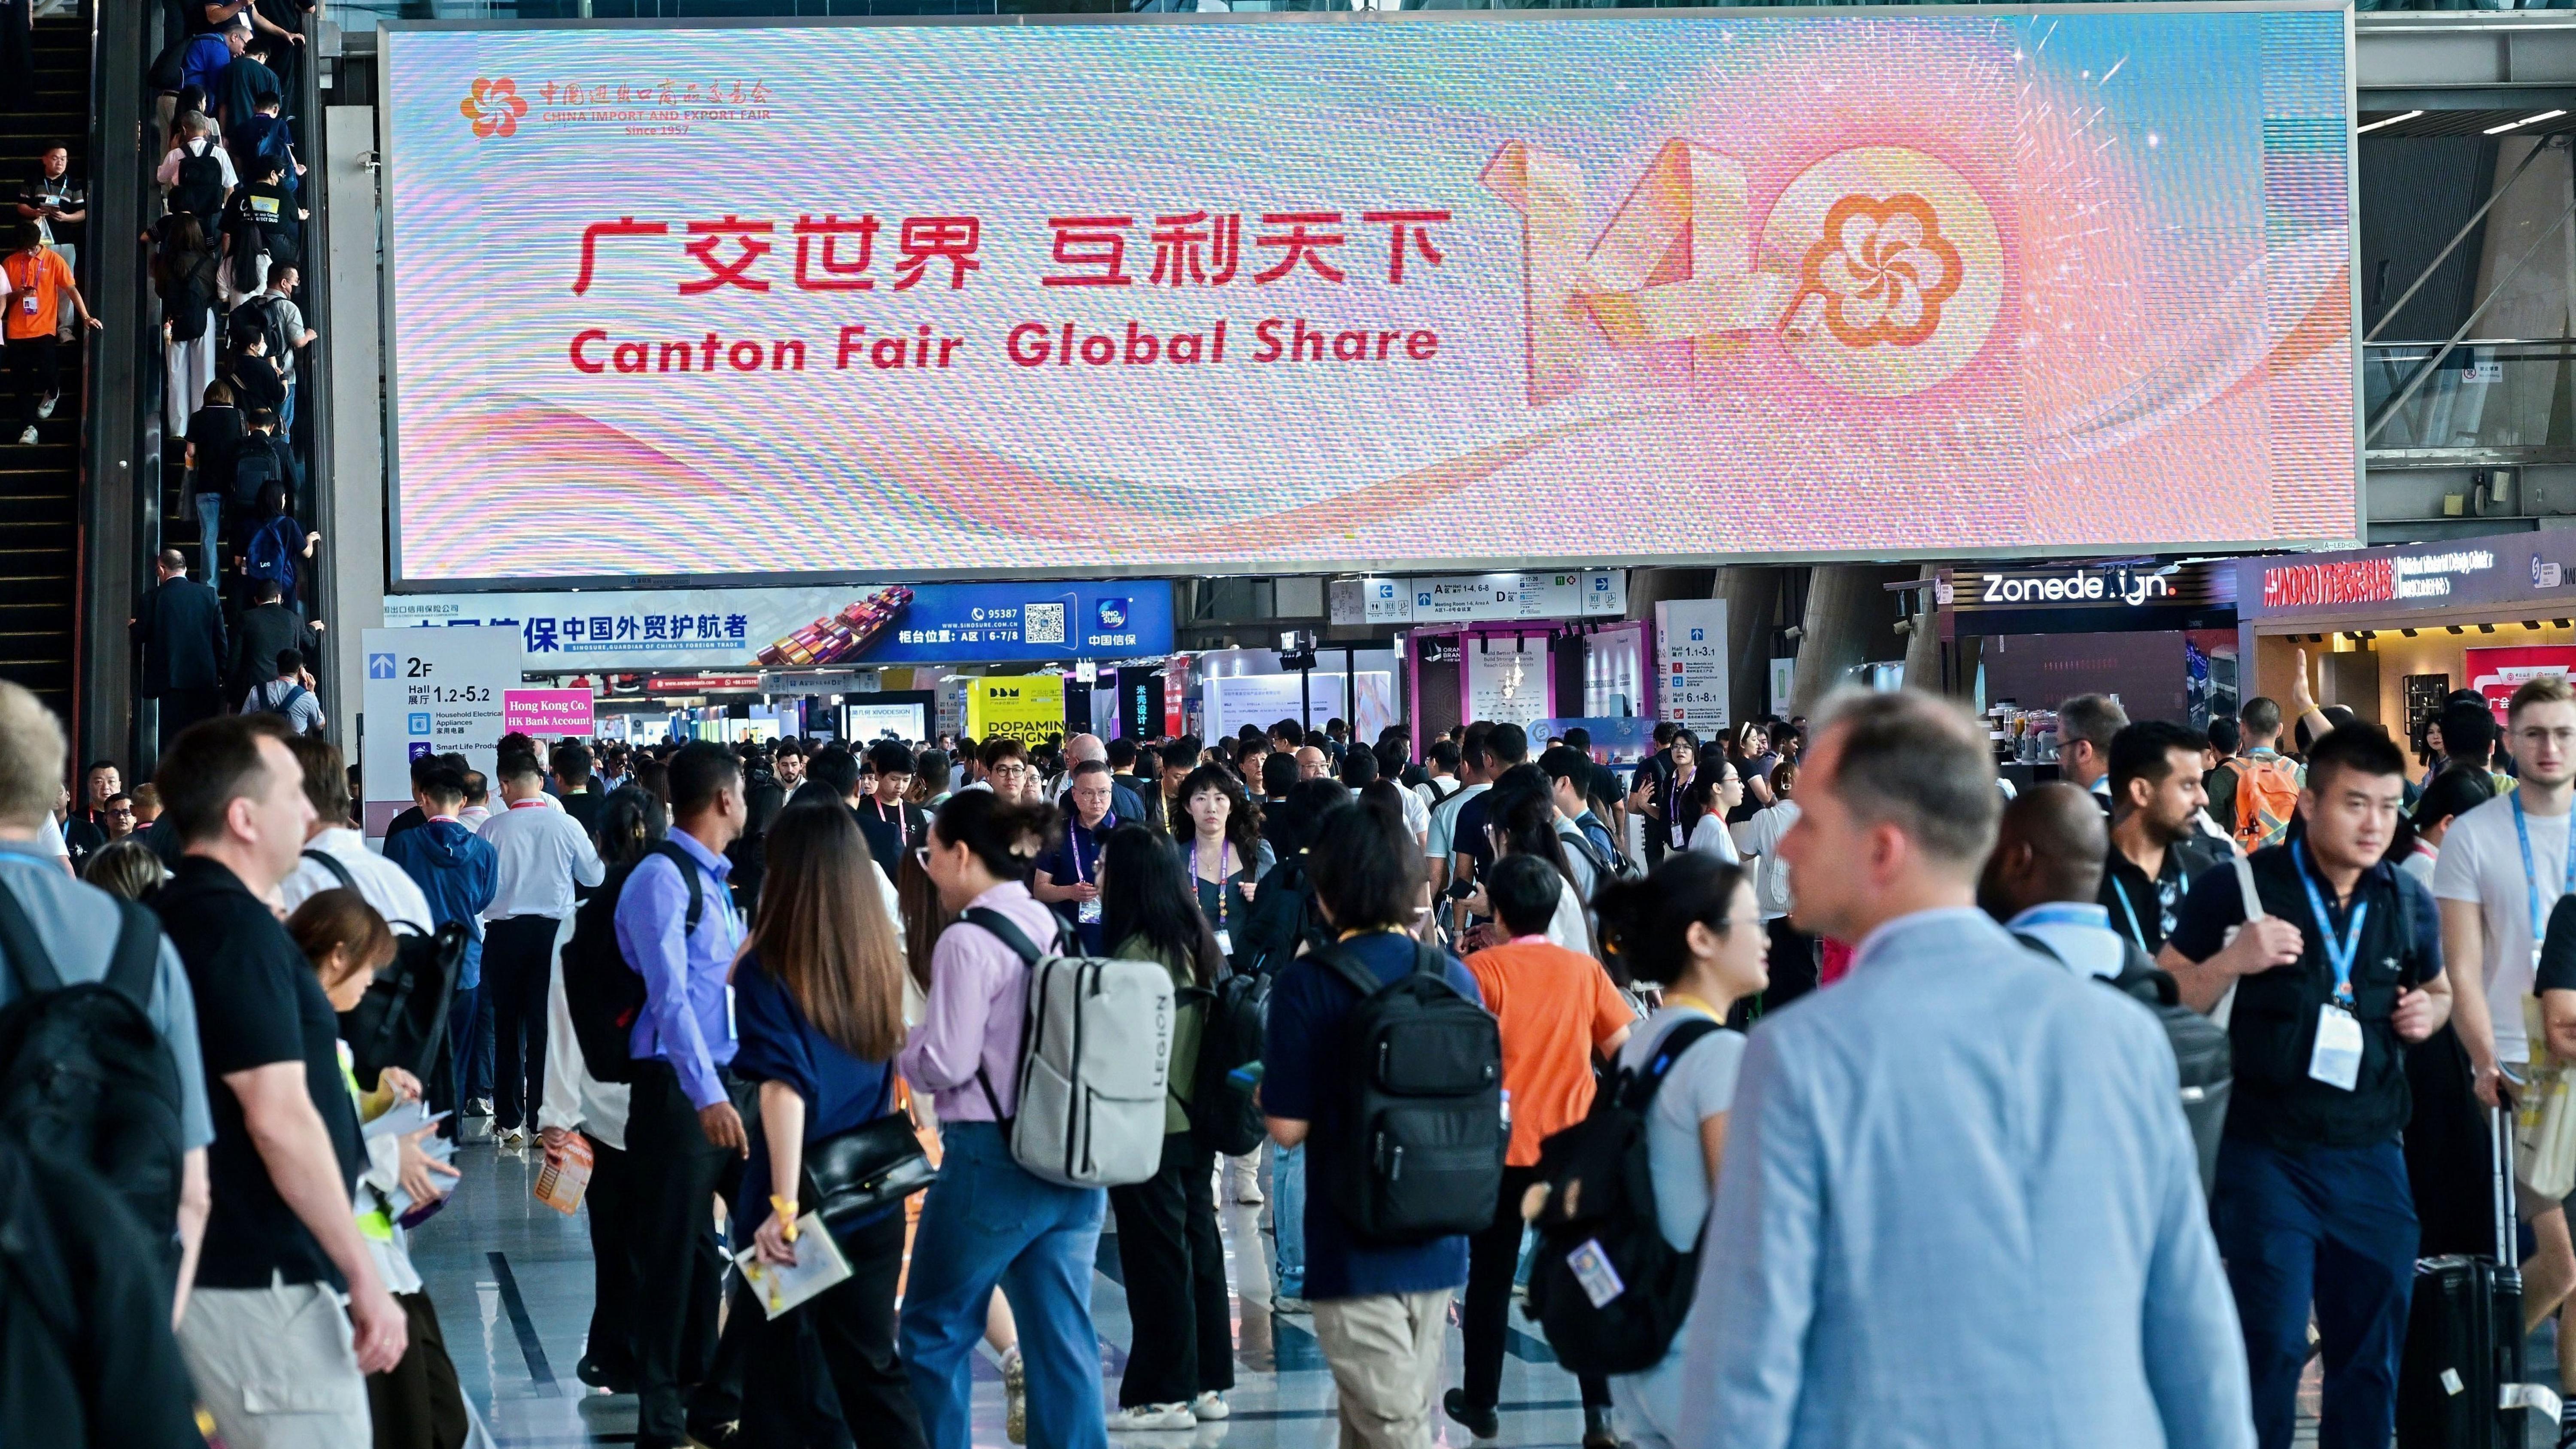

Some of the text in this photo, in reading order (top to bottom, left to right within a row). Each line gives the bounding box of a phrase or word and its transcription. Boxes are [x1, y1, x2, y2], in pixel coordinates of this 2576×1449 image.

[543, 109, 771, 122] CHINA IMPORT AND EXPORT FAIR
[626, 125, 689, 136] Since 1957
[571, 210, 1453, 297] 广交世界 互利天下
[569, 318, 1440, 374] Canton Fair Global Share
[1435, 584, 1443, 593] A
[1983, 570, 2176, 606] Zonedeign.
[1497, 592, 1505, 601] D
[988, 609, 1017, 618] 95387
[563, 614, 747, 641] 中国外贸护航者
[961, 632, 978, 642] A区
[989, 632, 1018, 642] 6-7/8
[1089, 635, 1136, 646] 中国信保
[1686, 647, 1715, 656] 1.1-3.1
[407, 657, 432, 677] 2F
[409, 685, 489, 702] Hall 1.2-5.2
[1687, 693, 1716, 702] 6.1-8.1
[409, 696, 429, 705] 展厅
[509, 700, 587, 713] Hong Kong Co.
[508, 716, 590, 726] HK Bank Account
[988, 720, 1065, 732] DOPAMIN
[1153, 995, 1167, 1087] LEGION
